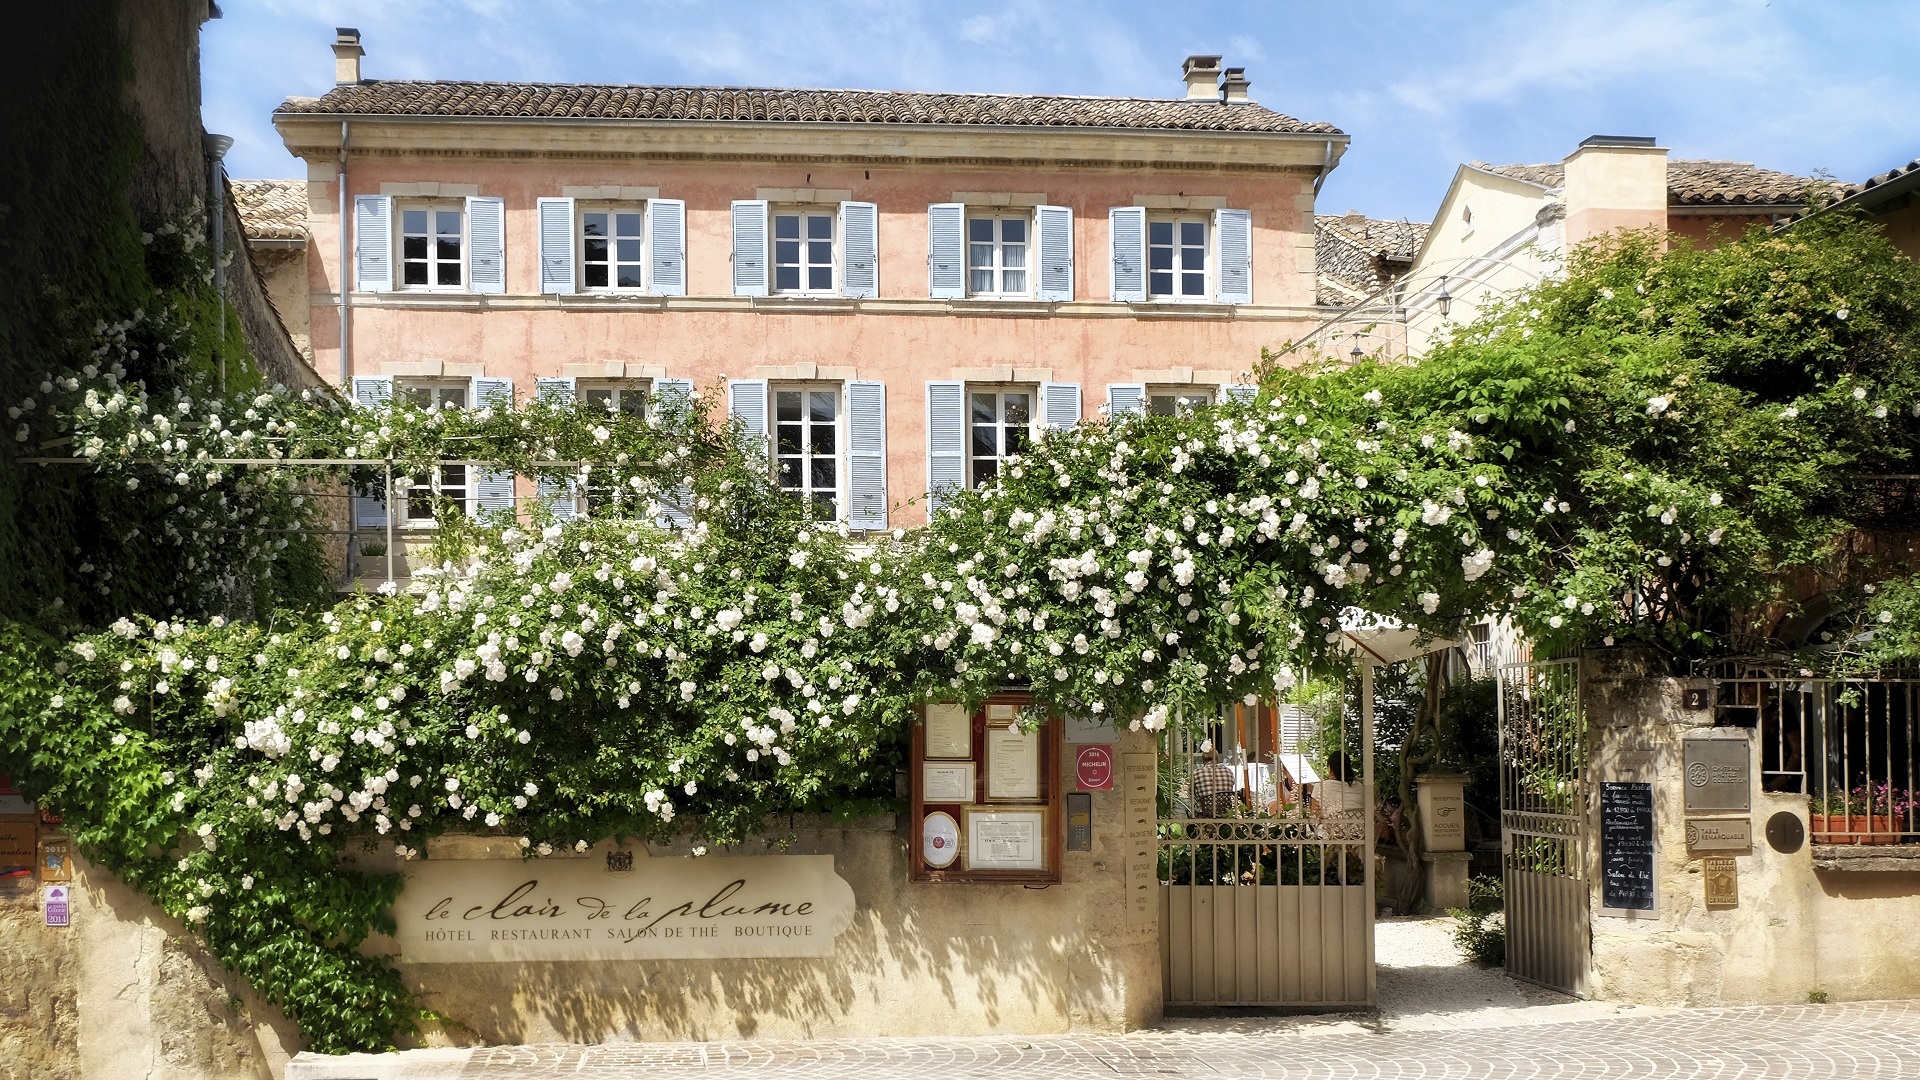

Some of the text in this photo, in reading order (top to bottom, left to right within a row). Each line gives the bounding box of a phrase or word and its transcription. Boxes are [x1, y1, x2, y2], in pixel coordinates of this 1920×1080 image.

[1692, 692, 1698, 706] 2
[423, 879, 814, 944] le clair de la plume
[426, 924, 813, 941] HÔTEL RESTAURANT SALON DE THÉ BOUTIQUE
